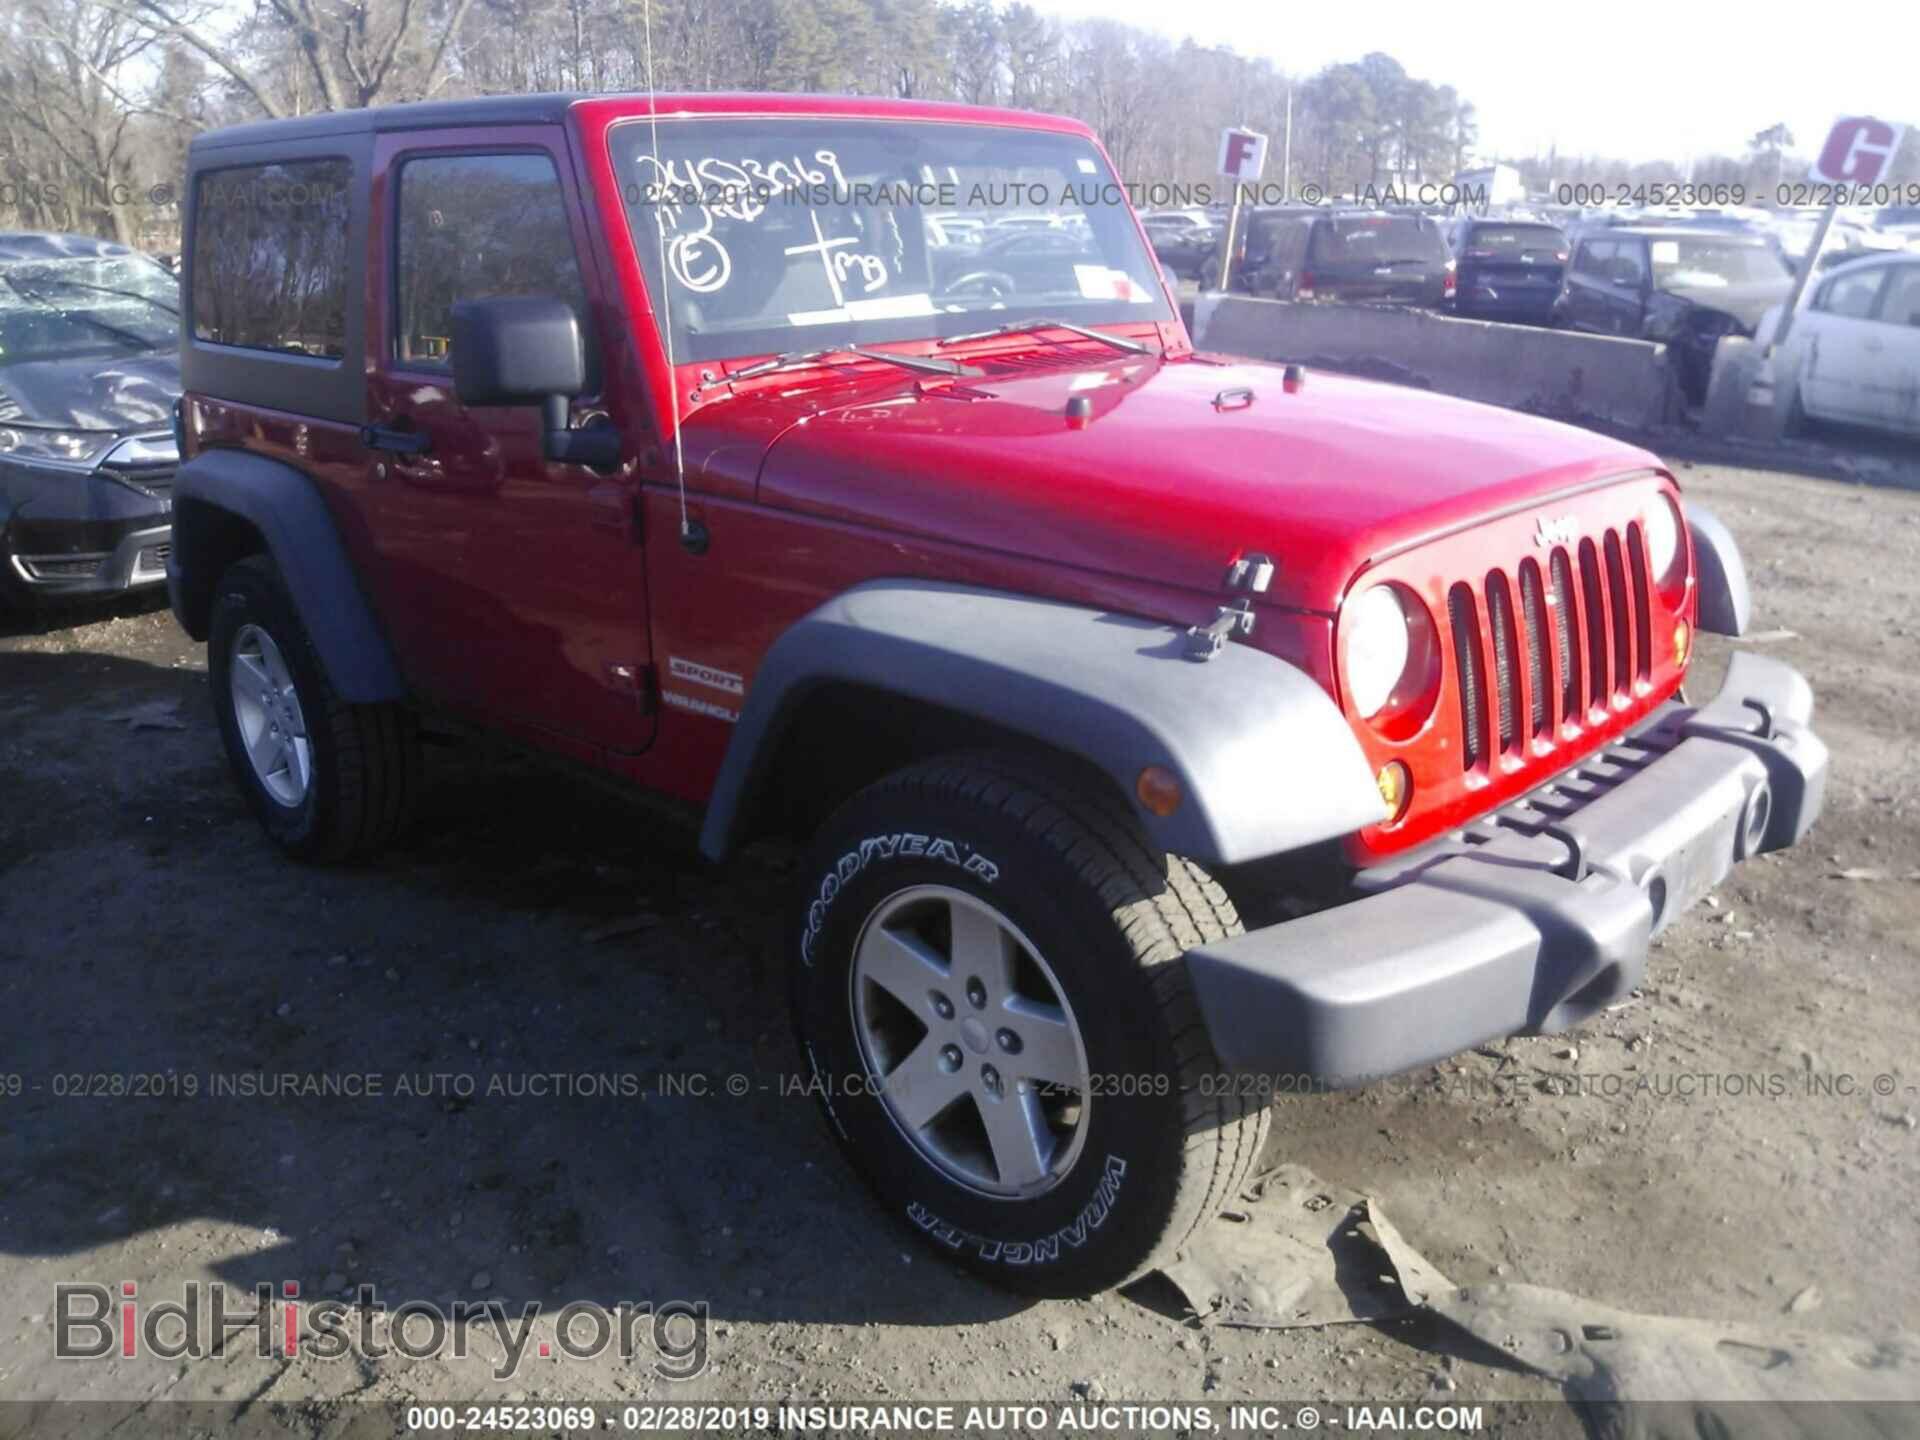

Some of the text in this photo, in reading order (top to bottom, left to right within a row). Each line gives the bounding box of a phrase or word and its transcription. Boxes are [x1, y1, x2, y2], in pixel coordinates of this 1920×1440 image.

[1223, 133, 1256, 176] F
[1817, 116, 1895, 185] G
[672, 661, 739, 689] SPORT
